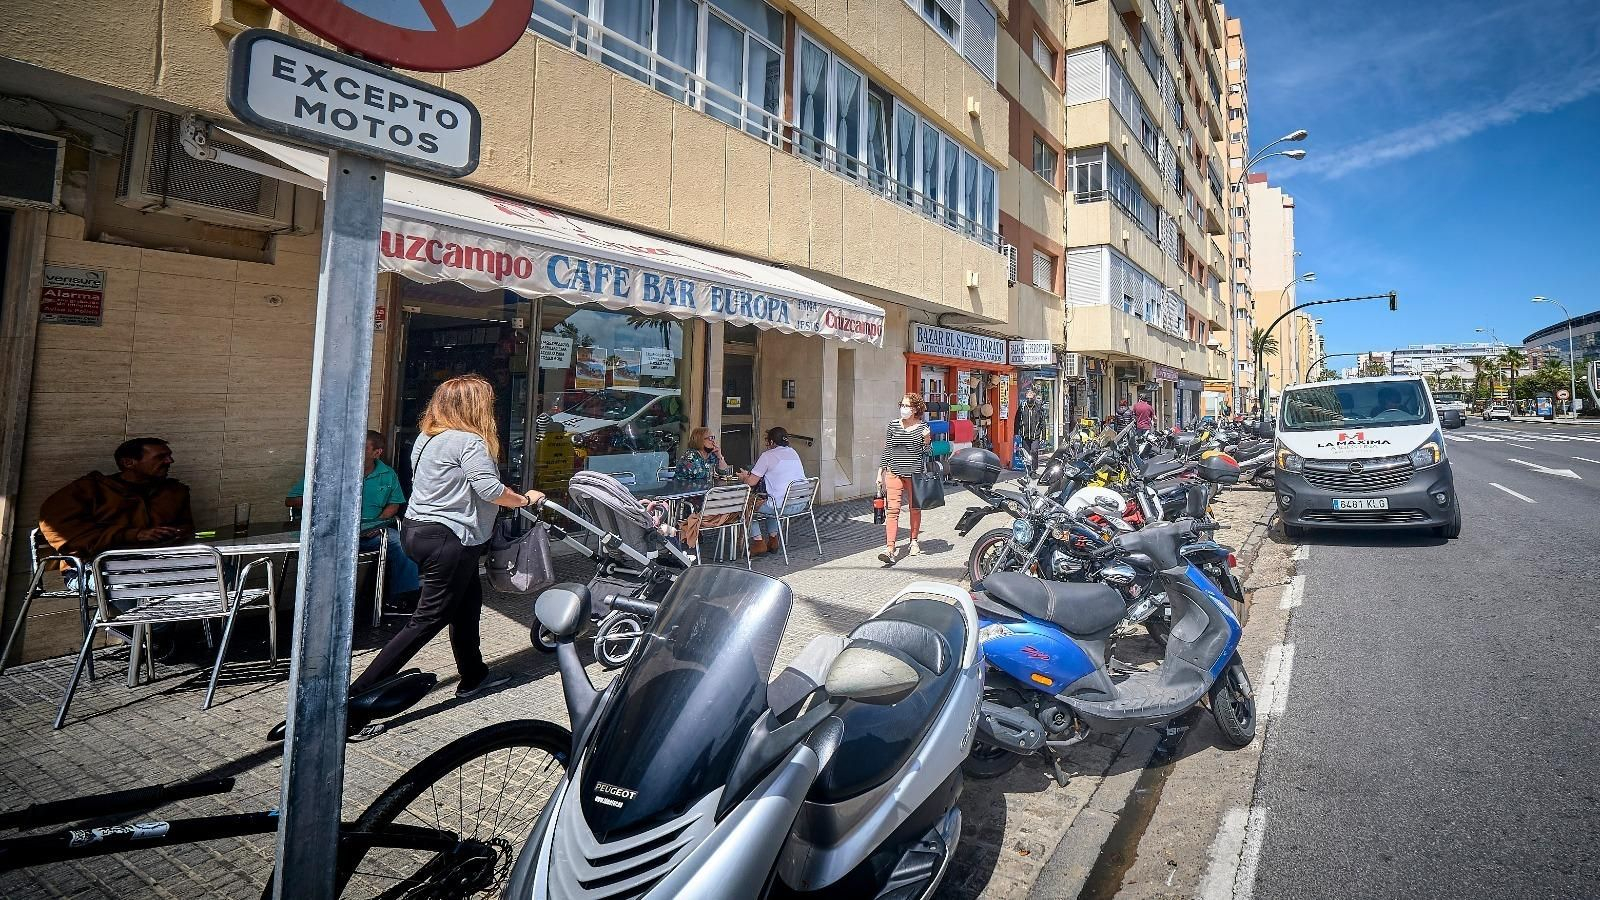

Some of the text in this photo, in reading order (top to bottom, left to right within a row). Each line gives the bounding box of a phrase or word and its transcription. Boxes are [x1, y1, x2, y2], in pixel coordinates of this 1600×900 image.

[272, 54, 459, 129] EXCEPTO
[294, 95, 439, 154] MOTOS
[381, 230, 533, 281] uzcampo
[44, 289, 100, 300] Alarma
[46, 275, 101, 286] verisure
[547, 254, 790, 324] CAFE BAR EUROPA
[825, 310, 882, 337] Cruzcampo
[917, 327, 943, 345] BAZAR
[945, 332, 955, 347] EL
[956, 333, 978, 352] SUPER
[981, 338, 1004, 356] BARATO
[594, 783, 637, 799] PEUGEOT
